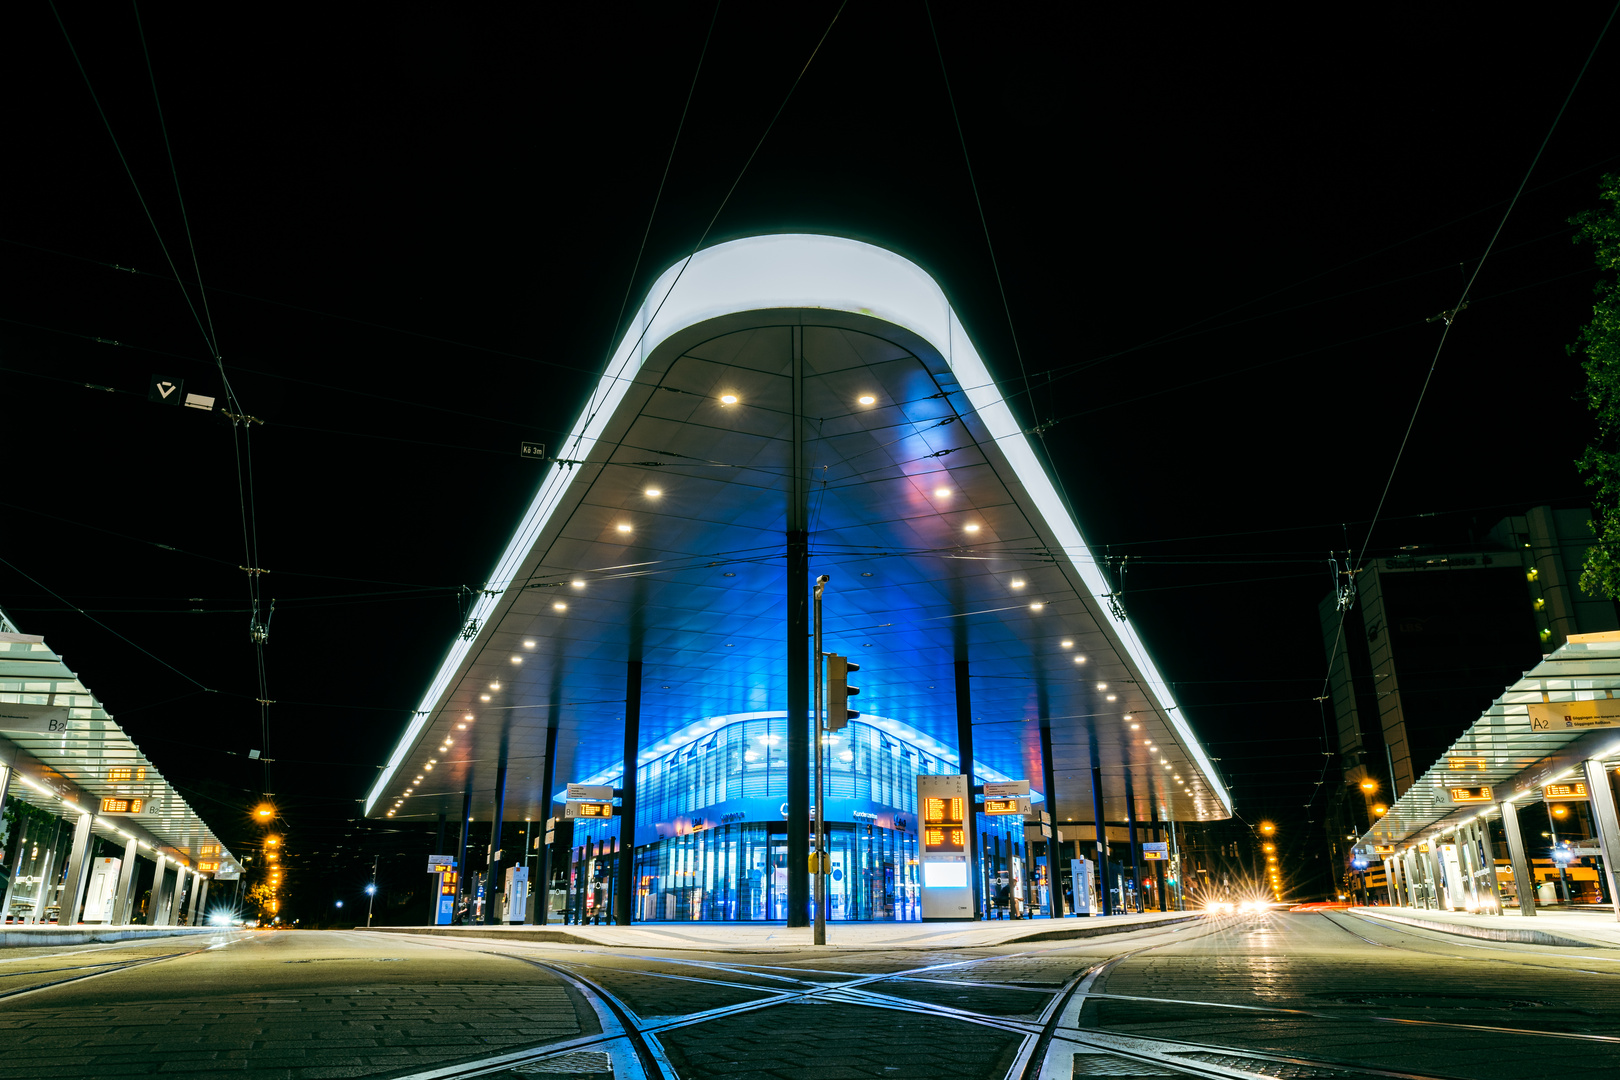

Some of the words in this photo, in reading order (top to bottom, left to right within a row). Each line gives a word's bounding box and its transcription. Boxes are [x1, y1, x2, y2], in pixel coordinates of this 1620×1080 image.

[533, 447, 543, 455] 3m
[49, 720, 64, 731] B2
[1534, 718, 1549, 729] A2
[150, 806, 159, 814] B2
